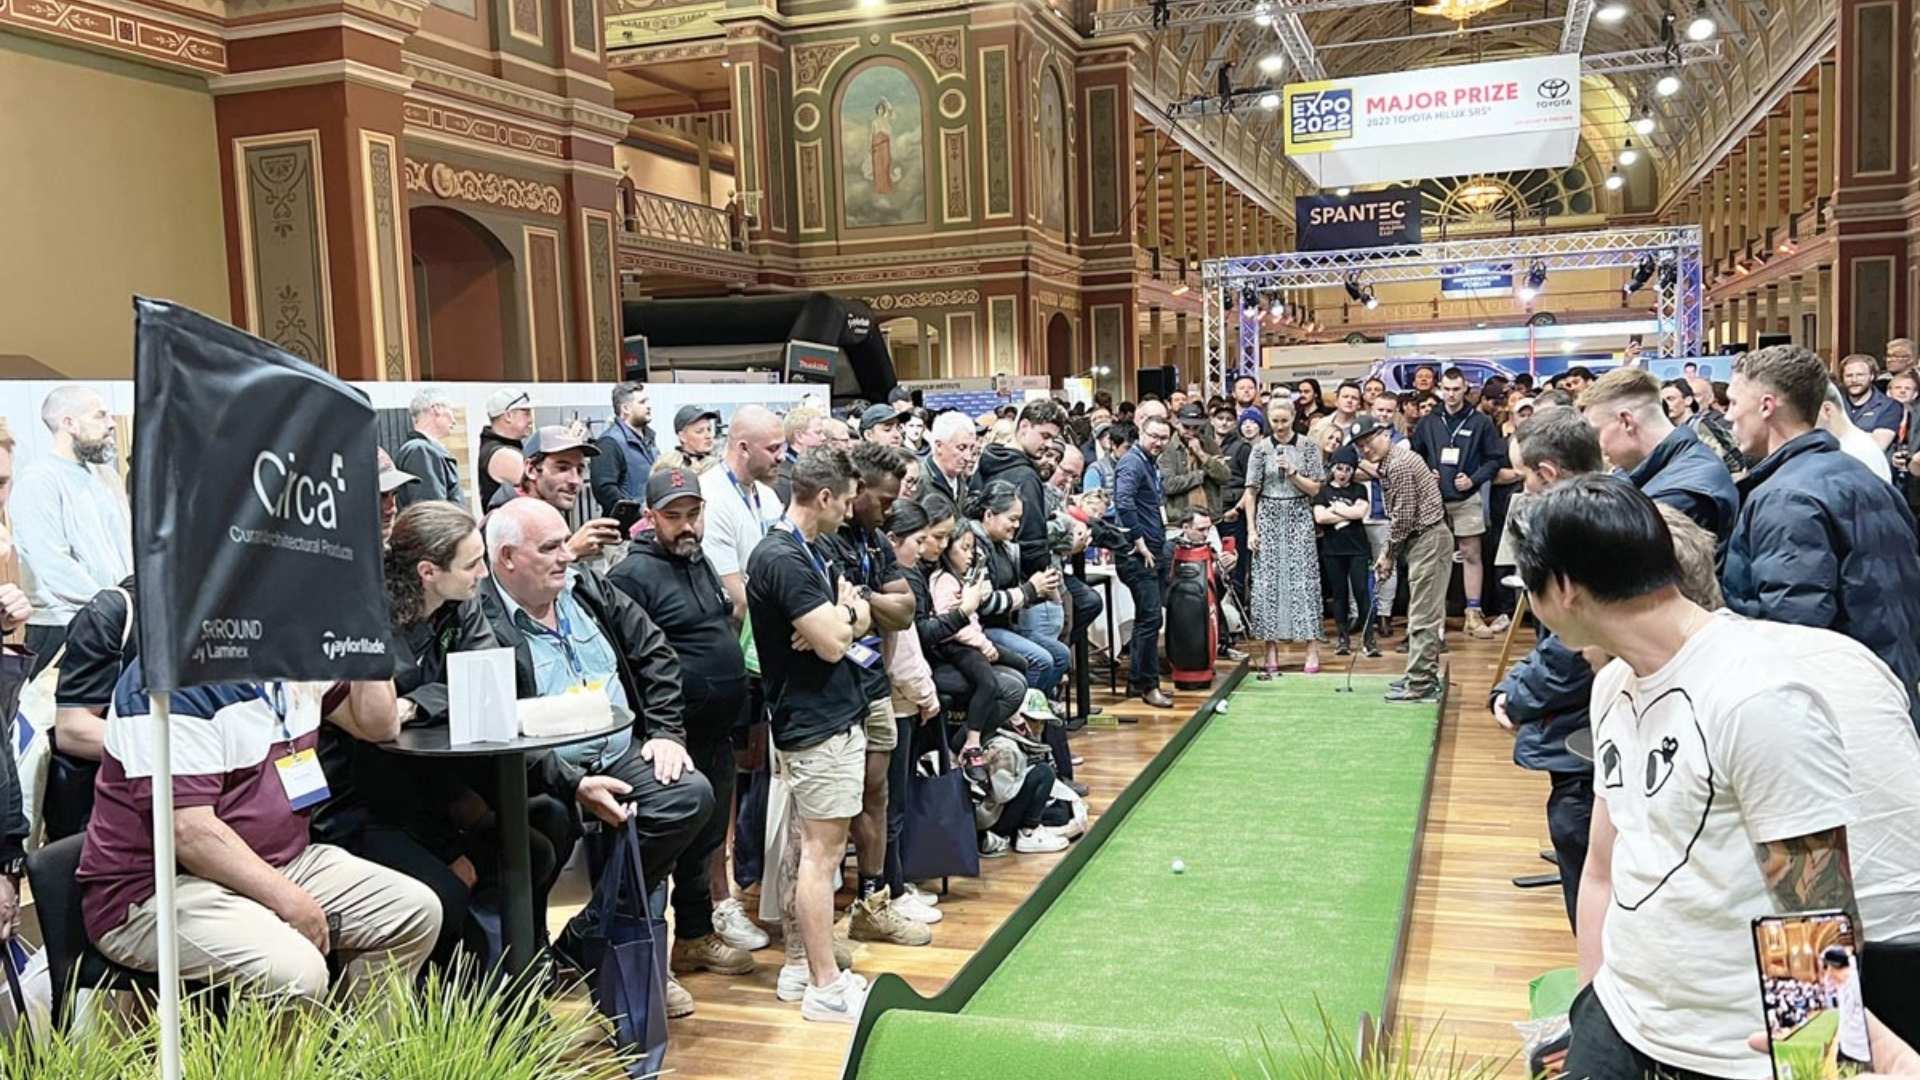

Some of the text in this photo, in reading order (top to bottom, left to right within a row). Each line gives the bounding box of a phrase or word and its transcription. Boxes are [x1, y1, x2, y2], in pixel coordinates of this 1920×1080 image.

[1293, 91, 1351, 117] EXPO
[1366, 82, 1519, 114] MAJOR PRIZE
[1537, 99, 1572, 109] TOYOTA
[1294, 113, 1351, 134] 2022
[1394, 112, 1433, 124] TOYOTA
[1310, 201, 1406, 225] SPANTEC
[253, 450, 337, 530] Circa
[323, 631, 385, 660] TaylorMade
